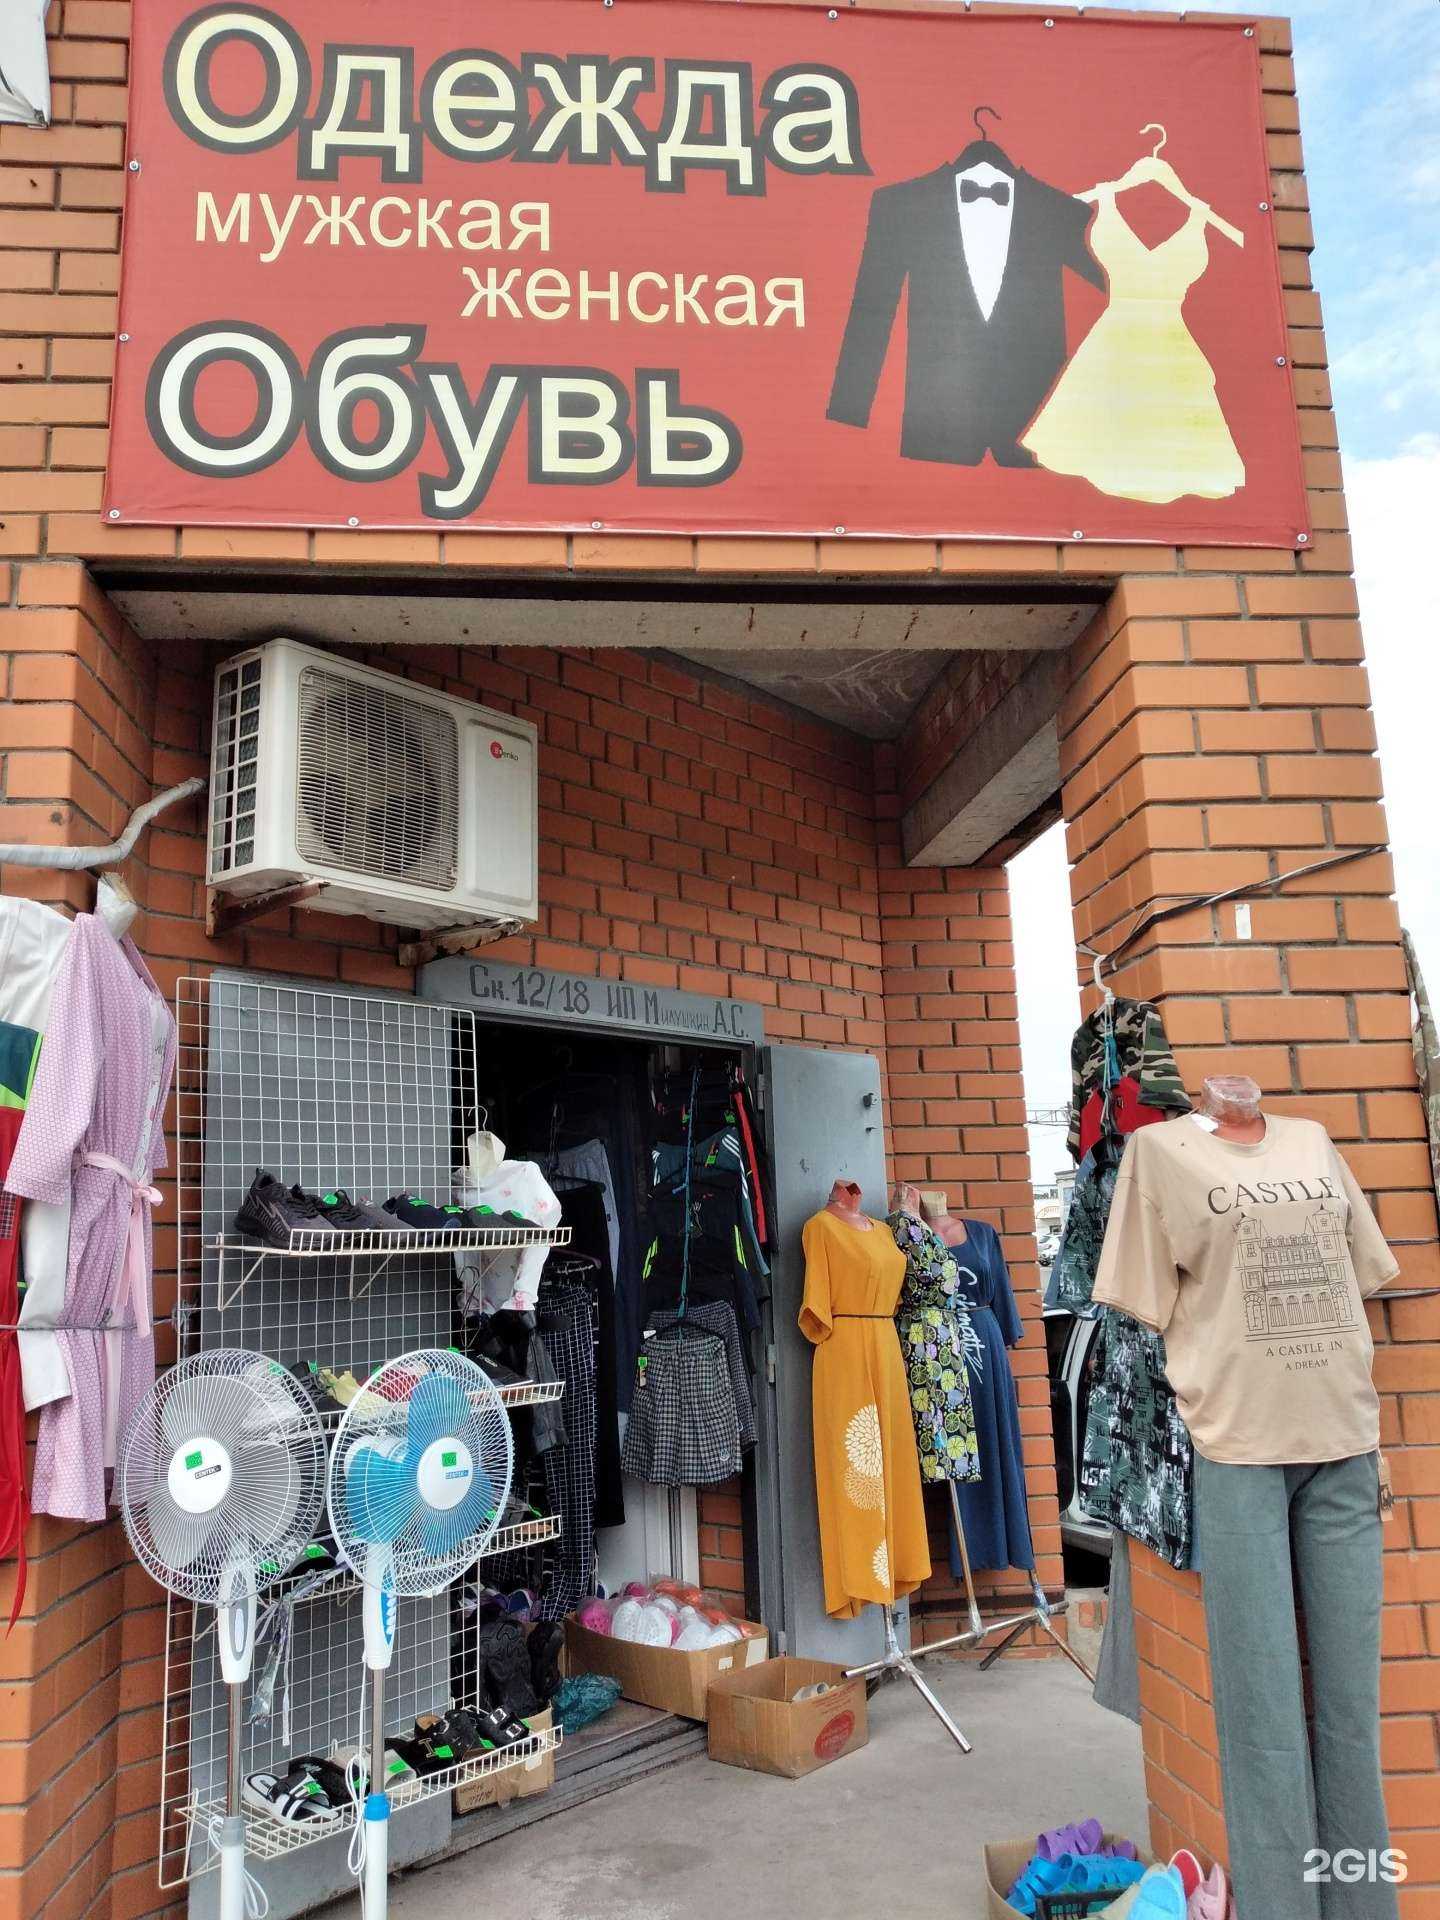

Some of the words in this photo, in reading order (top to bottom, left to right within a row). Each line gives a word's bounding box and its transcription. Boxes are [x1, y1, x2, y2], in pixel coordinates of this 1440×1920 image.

[164, 4, 872, 195] Одежда
[195, 190, 551, 263] мужская
[460, 265, 806, 328] женская
[146, 320, 742, 519] Обувь
[606, 984, 636, 1020] ИП
[1207, 1176, 1341, 1215] CASTLE
[1265, 1346, 1275, 1358] A
[1278, 1342, 1325, 1357] CASTLE
[1329, 1340, 1344, 1351] IN
[1284, 1362, 1293, 1371] A
[1295, 1358, 1329, 1370] DREAM
